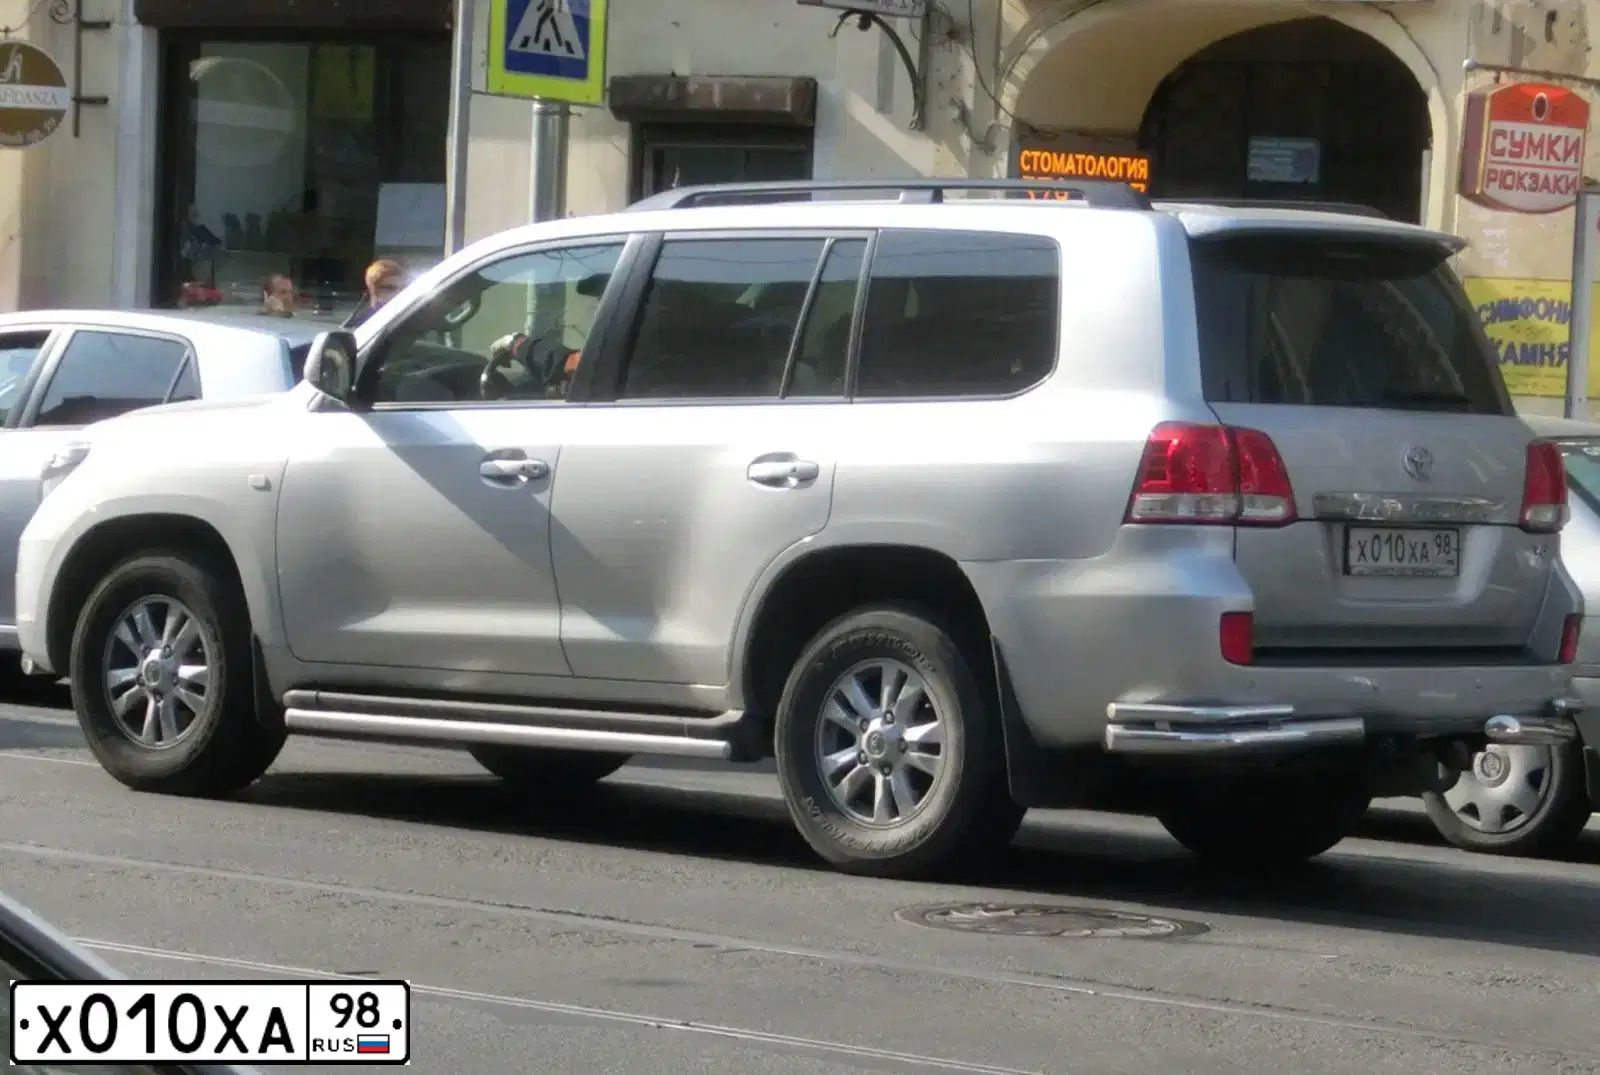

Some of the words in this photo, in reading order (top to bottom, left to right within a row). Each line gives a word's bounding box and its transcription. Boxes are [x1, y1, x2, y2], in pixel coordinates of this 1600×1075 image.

[1489, 128, 1582, 164] СУМКИ
[1020, 150, 1149, 180] СТОМАТОЛОГИЯ
[1485, 168, 1578, 196] РЮКЗАКИ
[1477, 296, 1571, 325] СИМФОНИ
[1356, 532, 1430, 564] Х010ХА
[1434, 533, 1452, 556] 98
